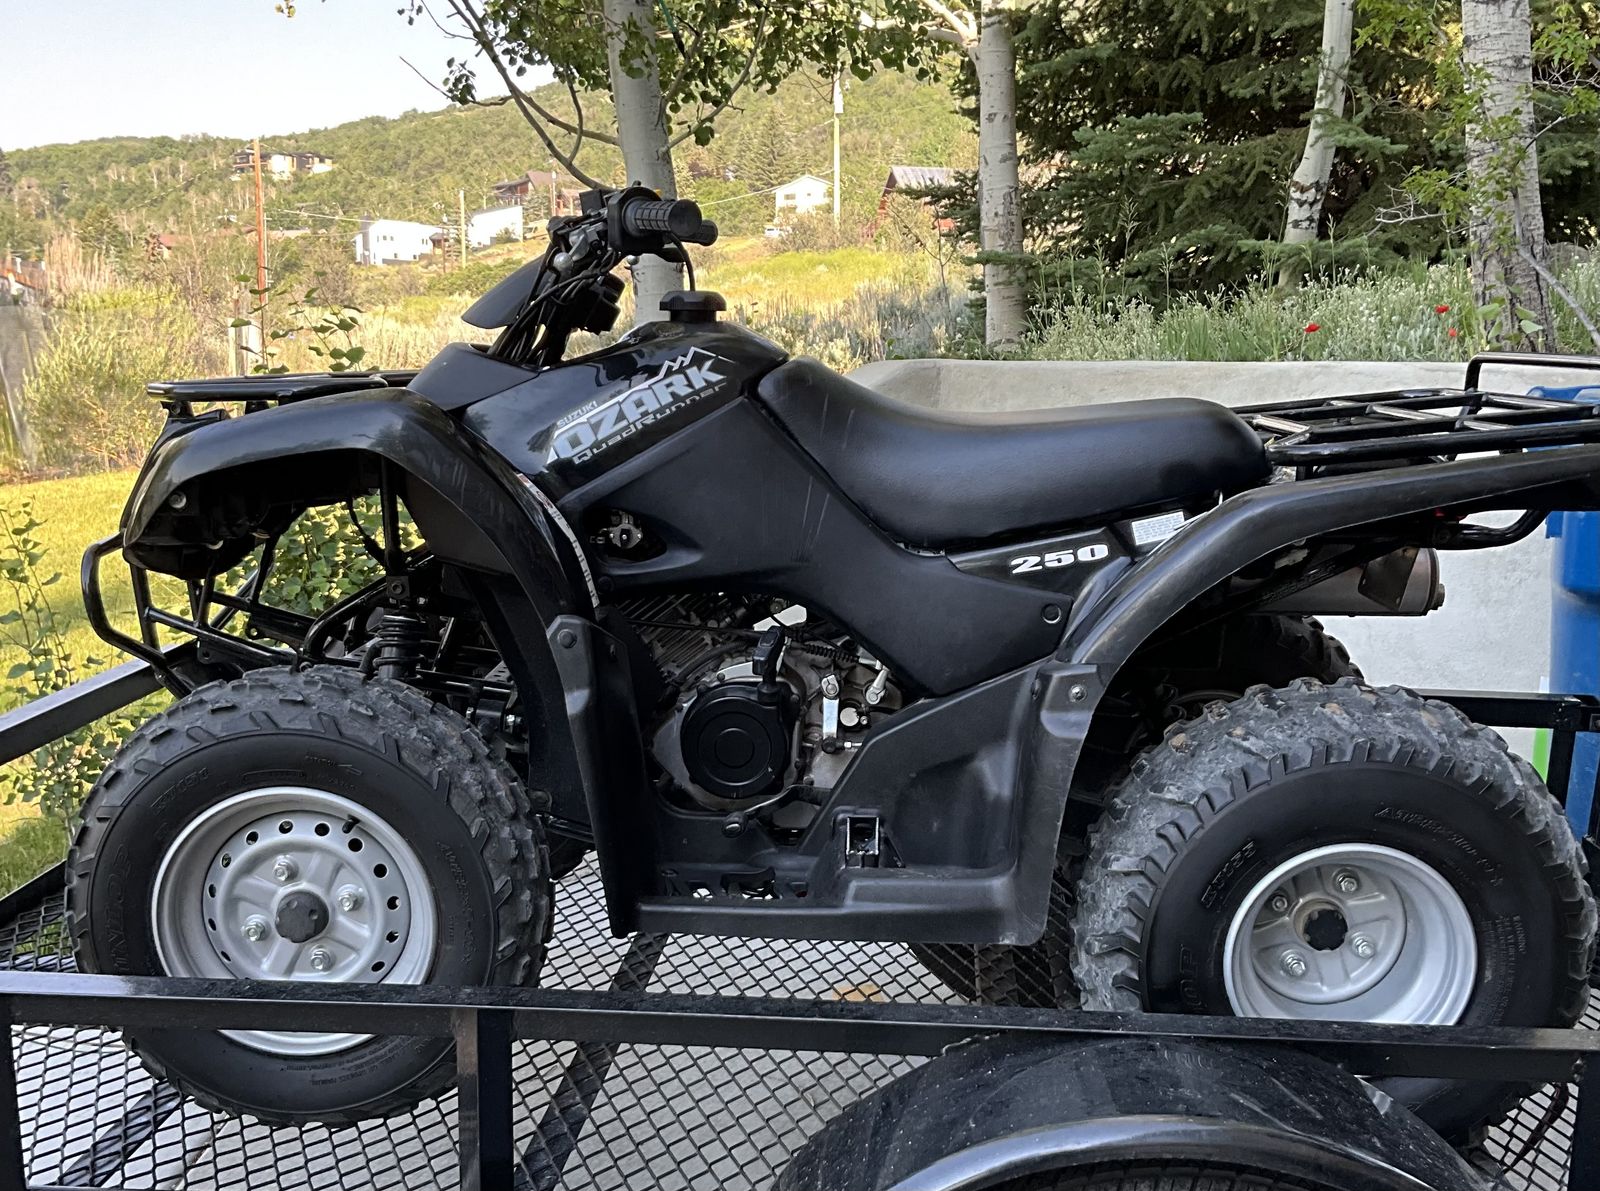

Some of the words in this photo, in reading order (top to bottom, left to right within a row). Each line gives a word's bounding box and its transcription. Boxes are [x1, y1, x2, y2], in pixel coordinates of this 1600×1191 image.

[552, 358, 727, 458] OZARK
[556, 400, 598, 428] SUZUKI
[1010, 544, 1109, 574] 250
